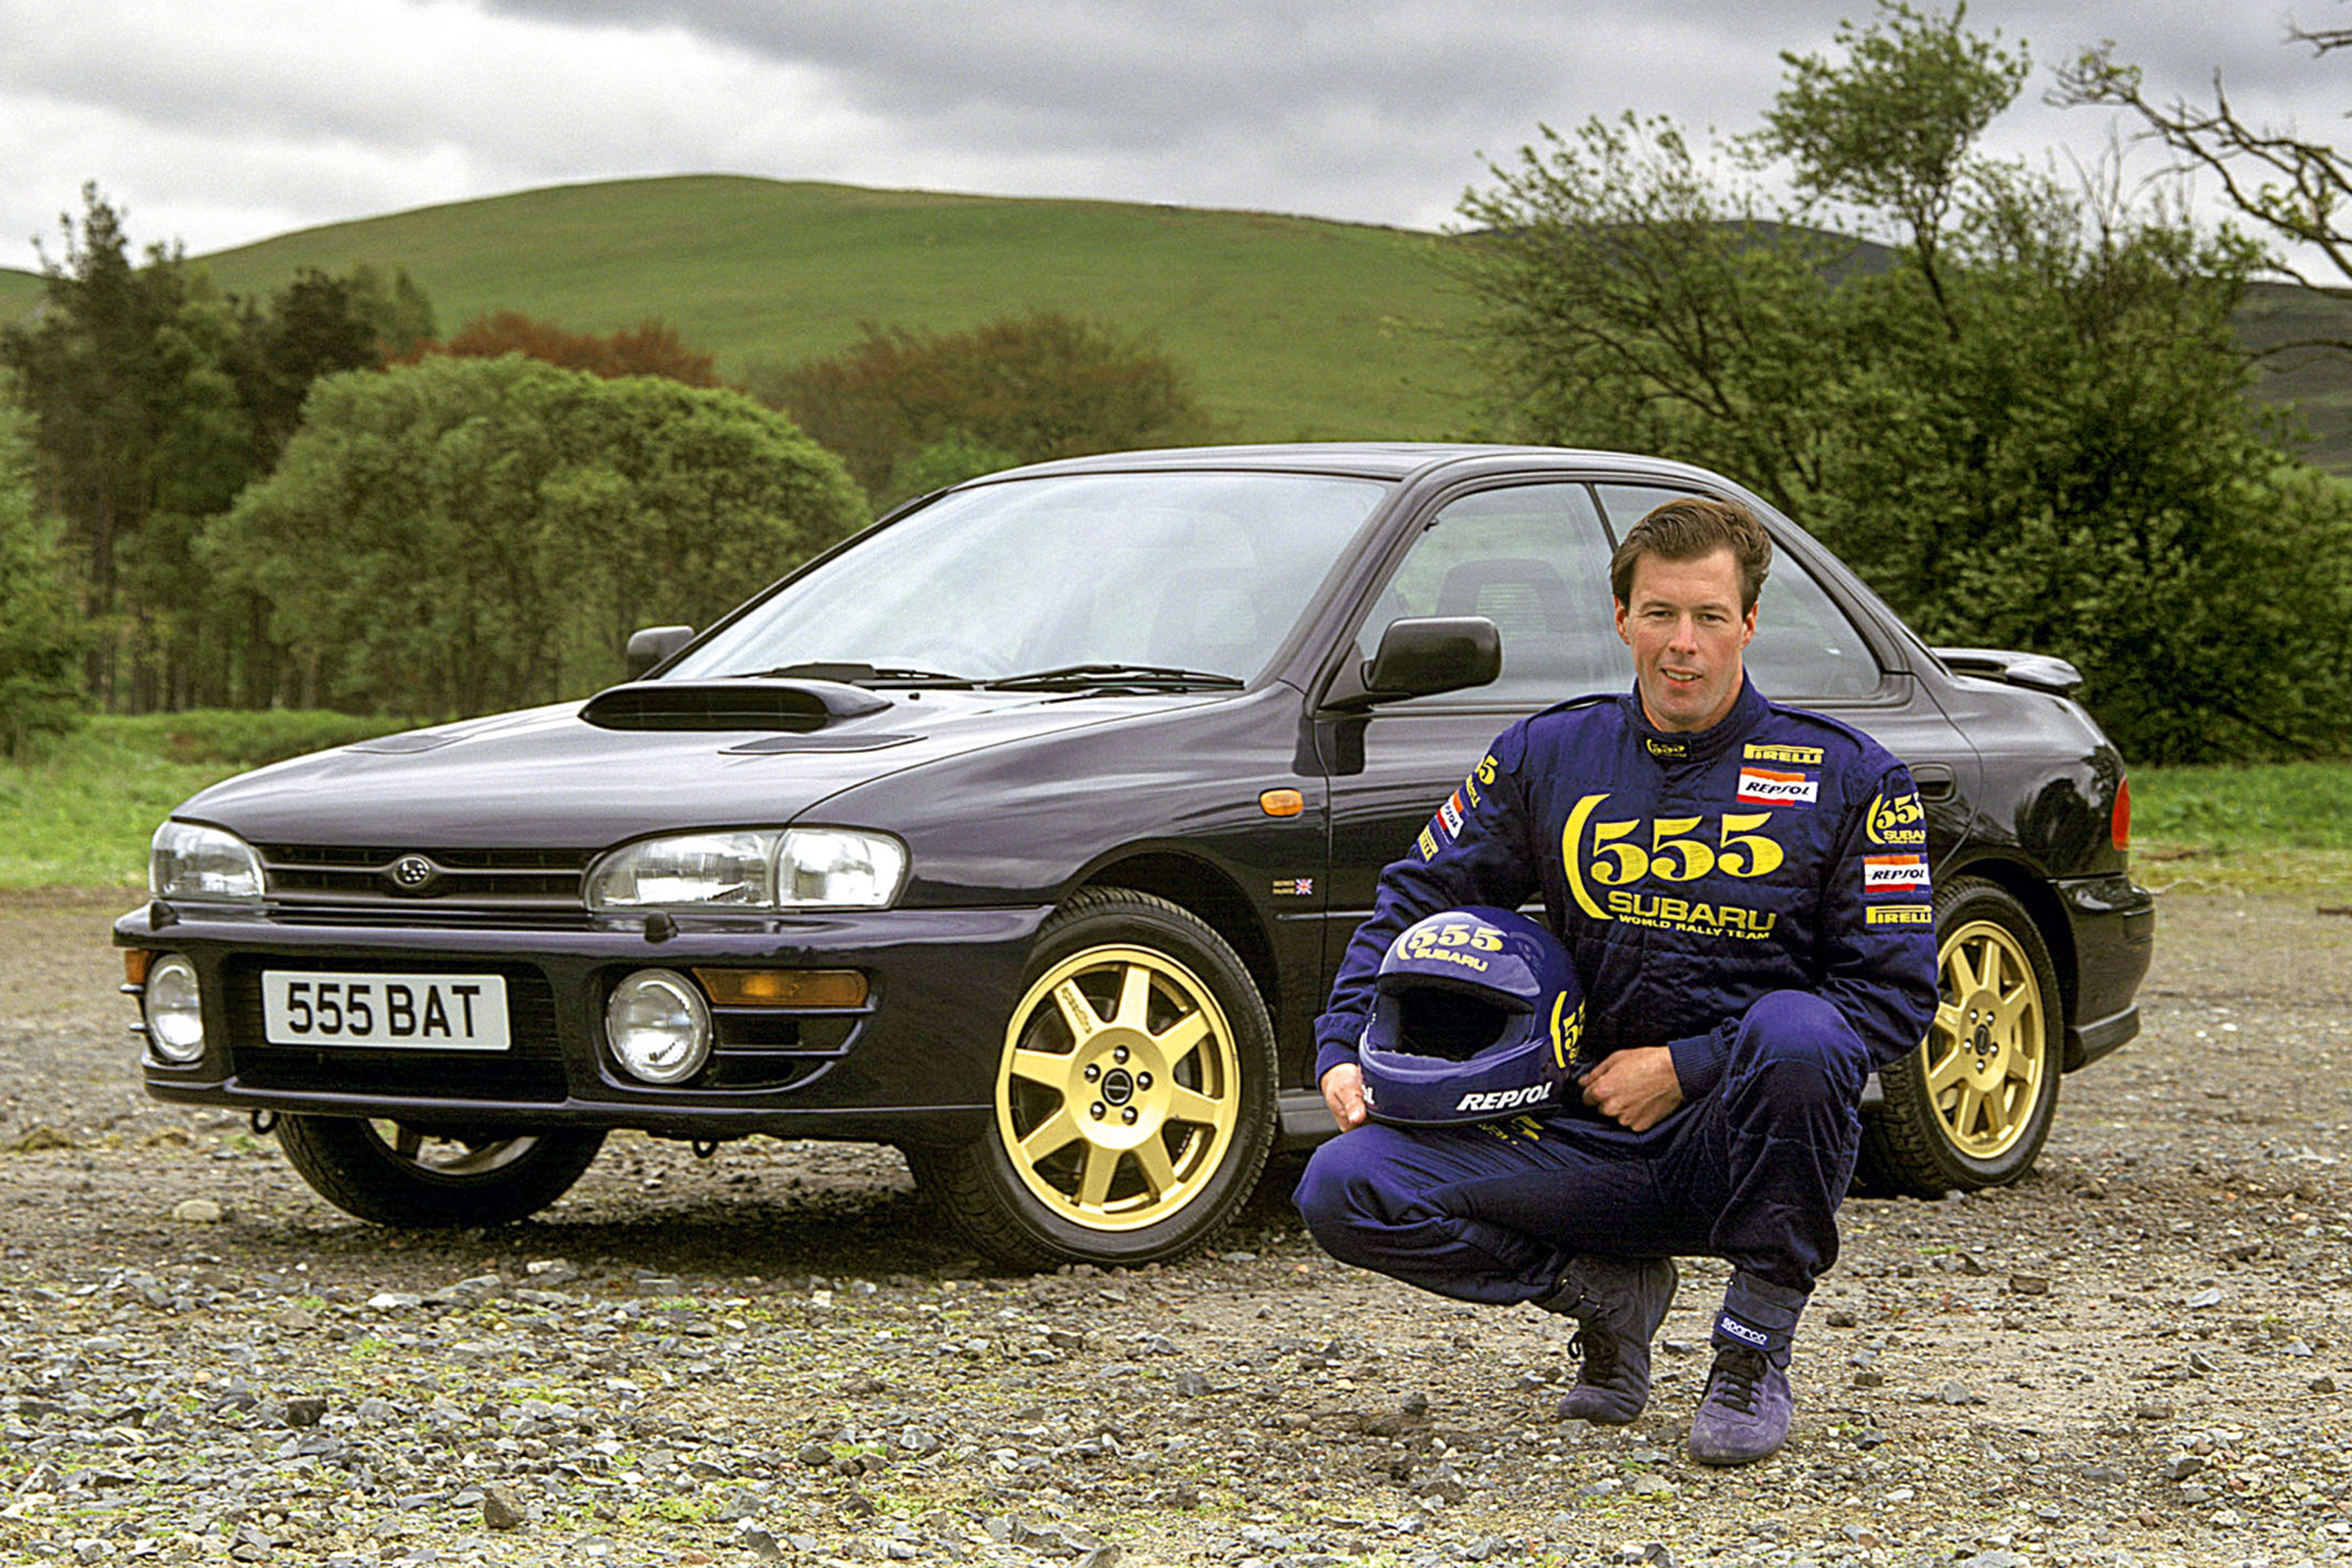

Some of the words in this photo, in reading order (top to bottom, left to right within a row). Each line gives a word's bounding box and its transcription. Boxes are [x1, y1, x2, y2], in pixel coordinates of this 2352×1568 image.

[1743, 744, 1824, 764] PIRELLI
[1745, 781, 1810, 796] REPSOL
[1591, 811, 1784, 886] 555
[1872, 869, 1925, 880] REPSOL
[1608, 890, 1777, 931] SUBARU
[1866, 905, 1933, 924] PIRELLI
[1408, 924, 1503, 952] 555
[1619, 913, 1671, 929] WORLD
[1676, 922, 1723, 936] RALLY
[1727, 929, 1770, 940] TEAM
[1414, 948, 1489, 972] SUBARU
[287, 982, 373, 1037] 555
[385, 983, 481, 1039] BAT
[1456, 1081, 1553, 1111] REPSOL
